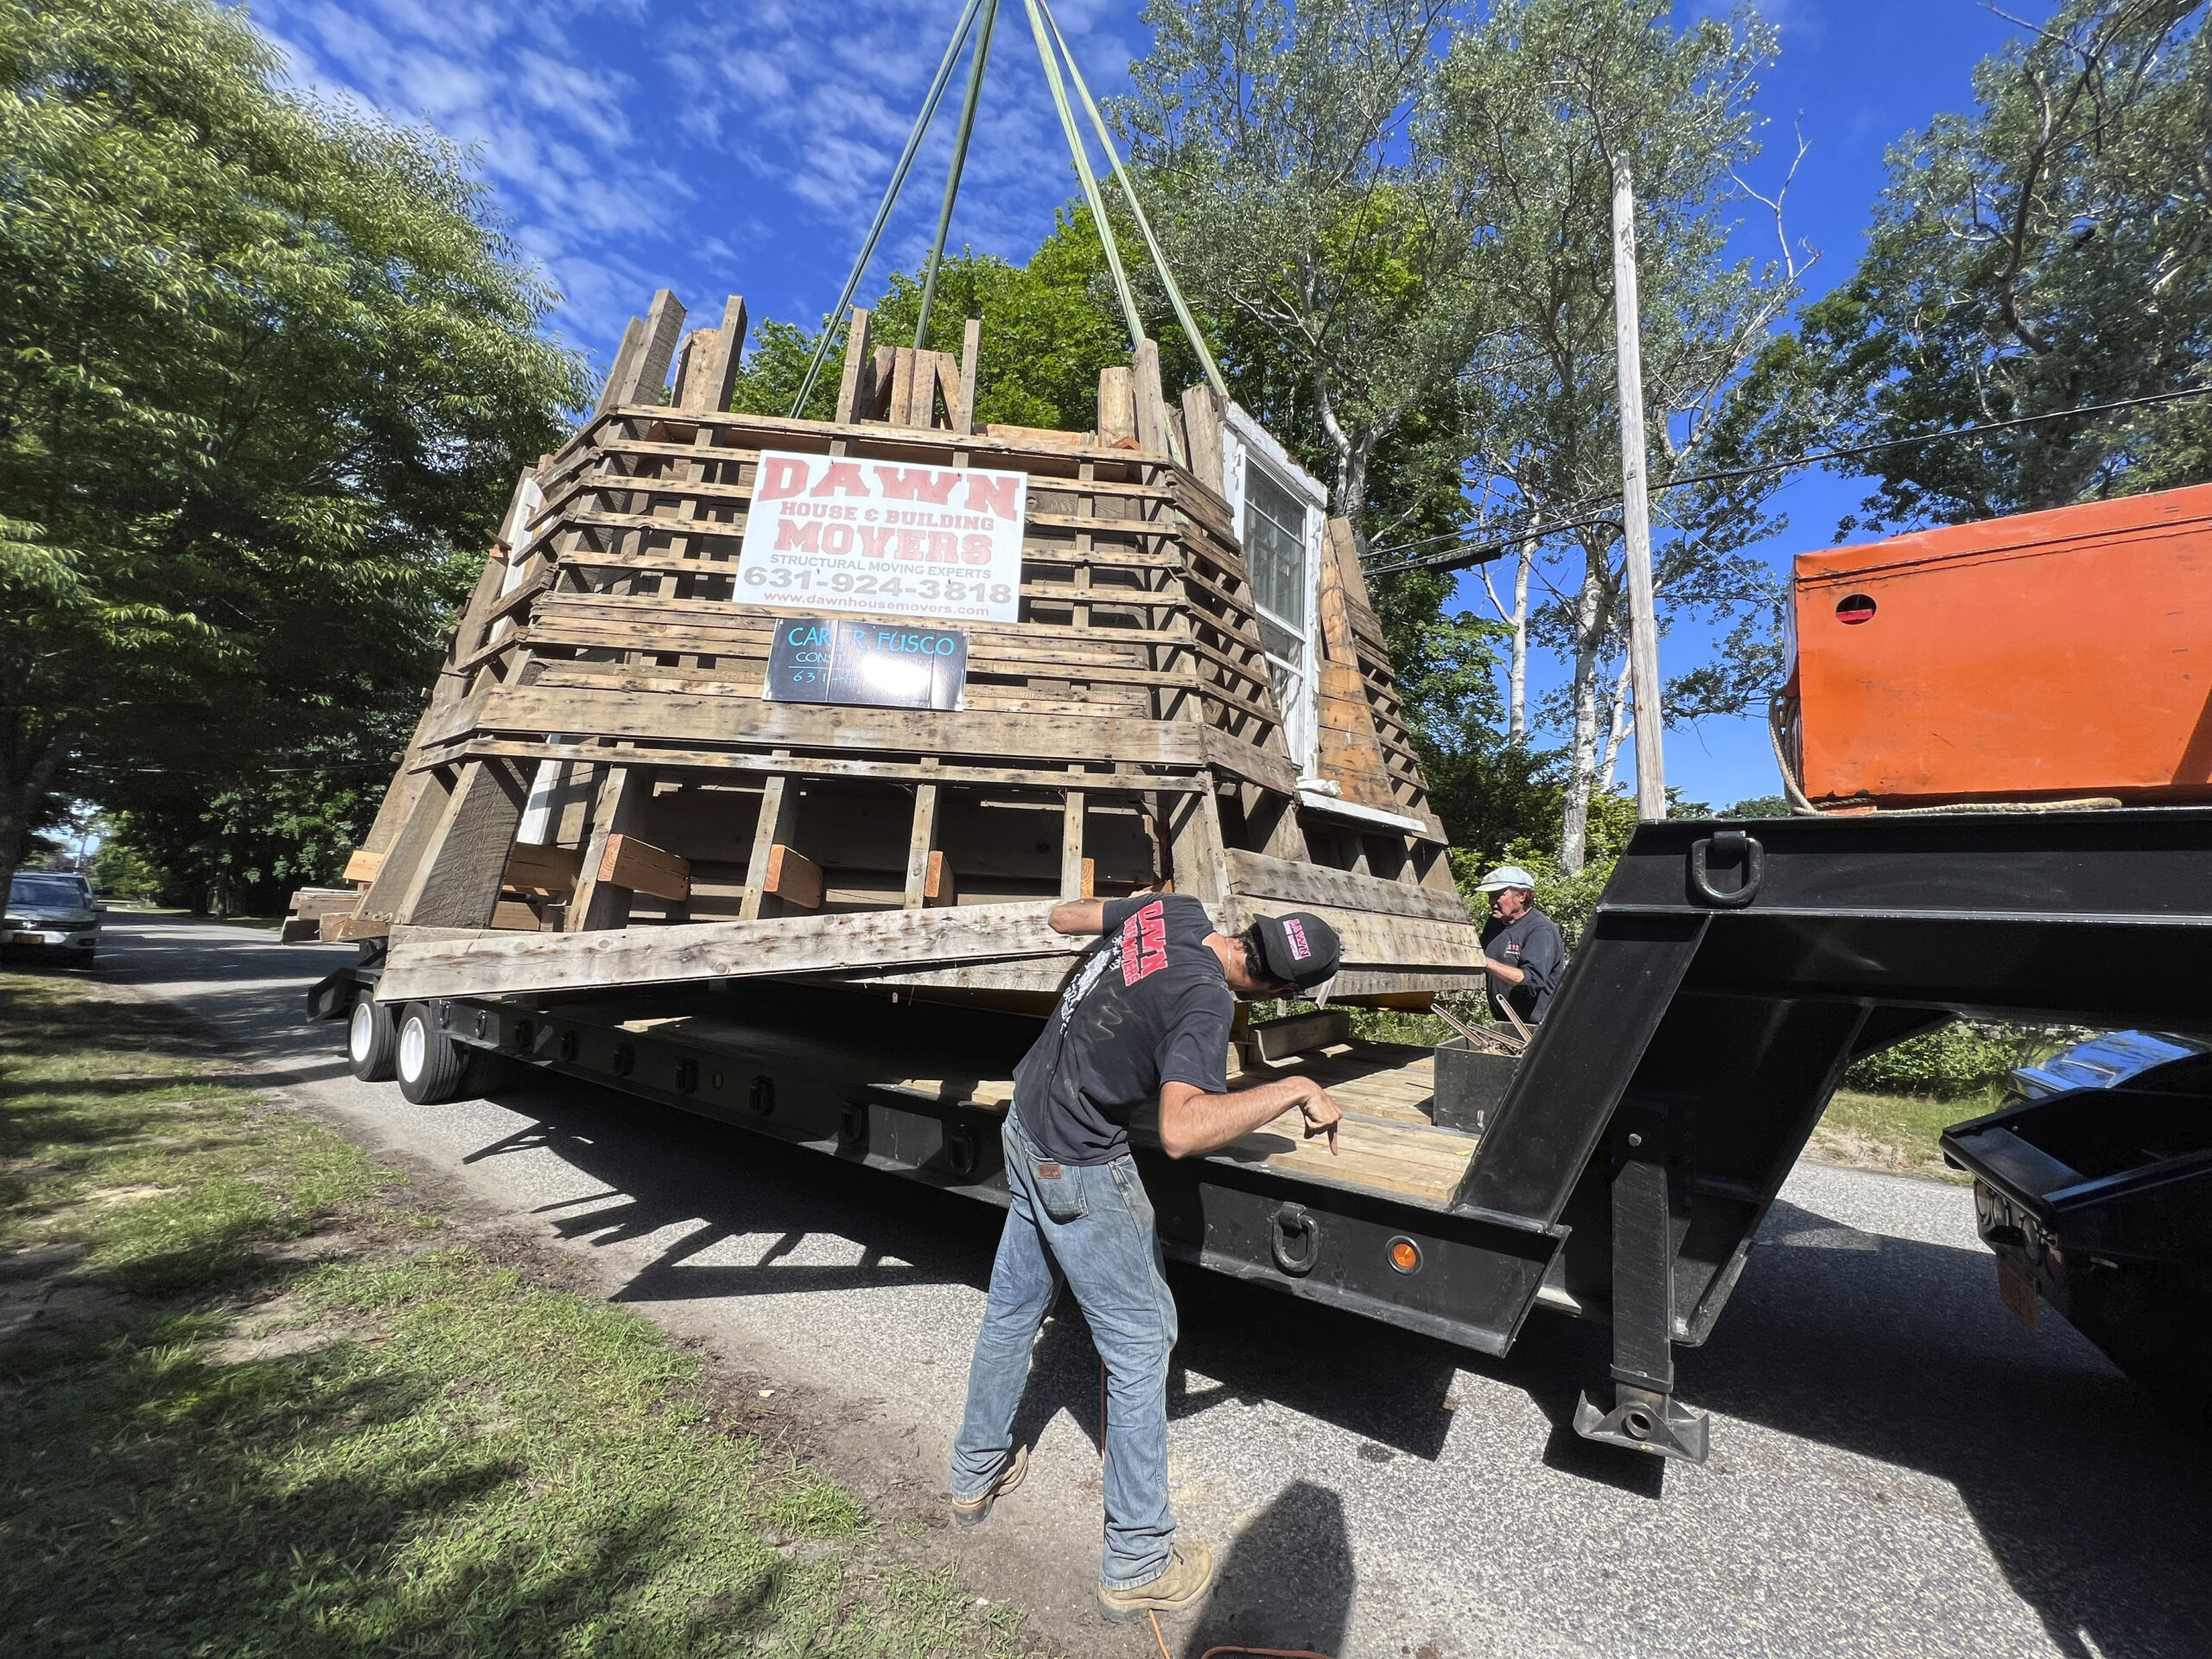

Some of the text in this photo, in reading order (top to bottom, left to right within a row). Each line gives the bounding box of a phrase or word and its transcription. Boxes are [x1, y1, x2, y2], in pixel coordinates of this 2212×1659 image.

[757, 456, 1020, 522] DAWN
[779, 500, 858, 522] HOUSE
[885, 510, 995, 531] BUILDING
[773, 519, 993, 565] MOVERS
[769, 554, 991, 579] STRUCTURAL MOVING EXPERTS
[744, 566, 1012, 604] 631-924-3818
[764, 591, 989, 616] www.dawnhousemovers.com
[788, 626, 839, 646] CAR
[877, 632, 955, 656] FUSCO
